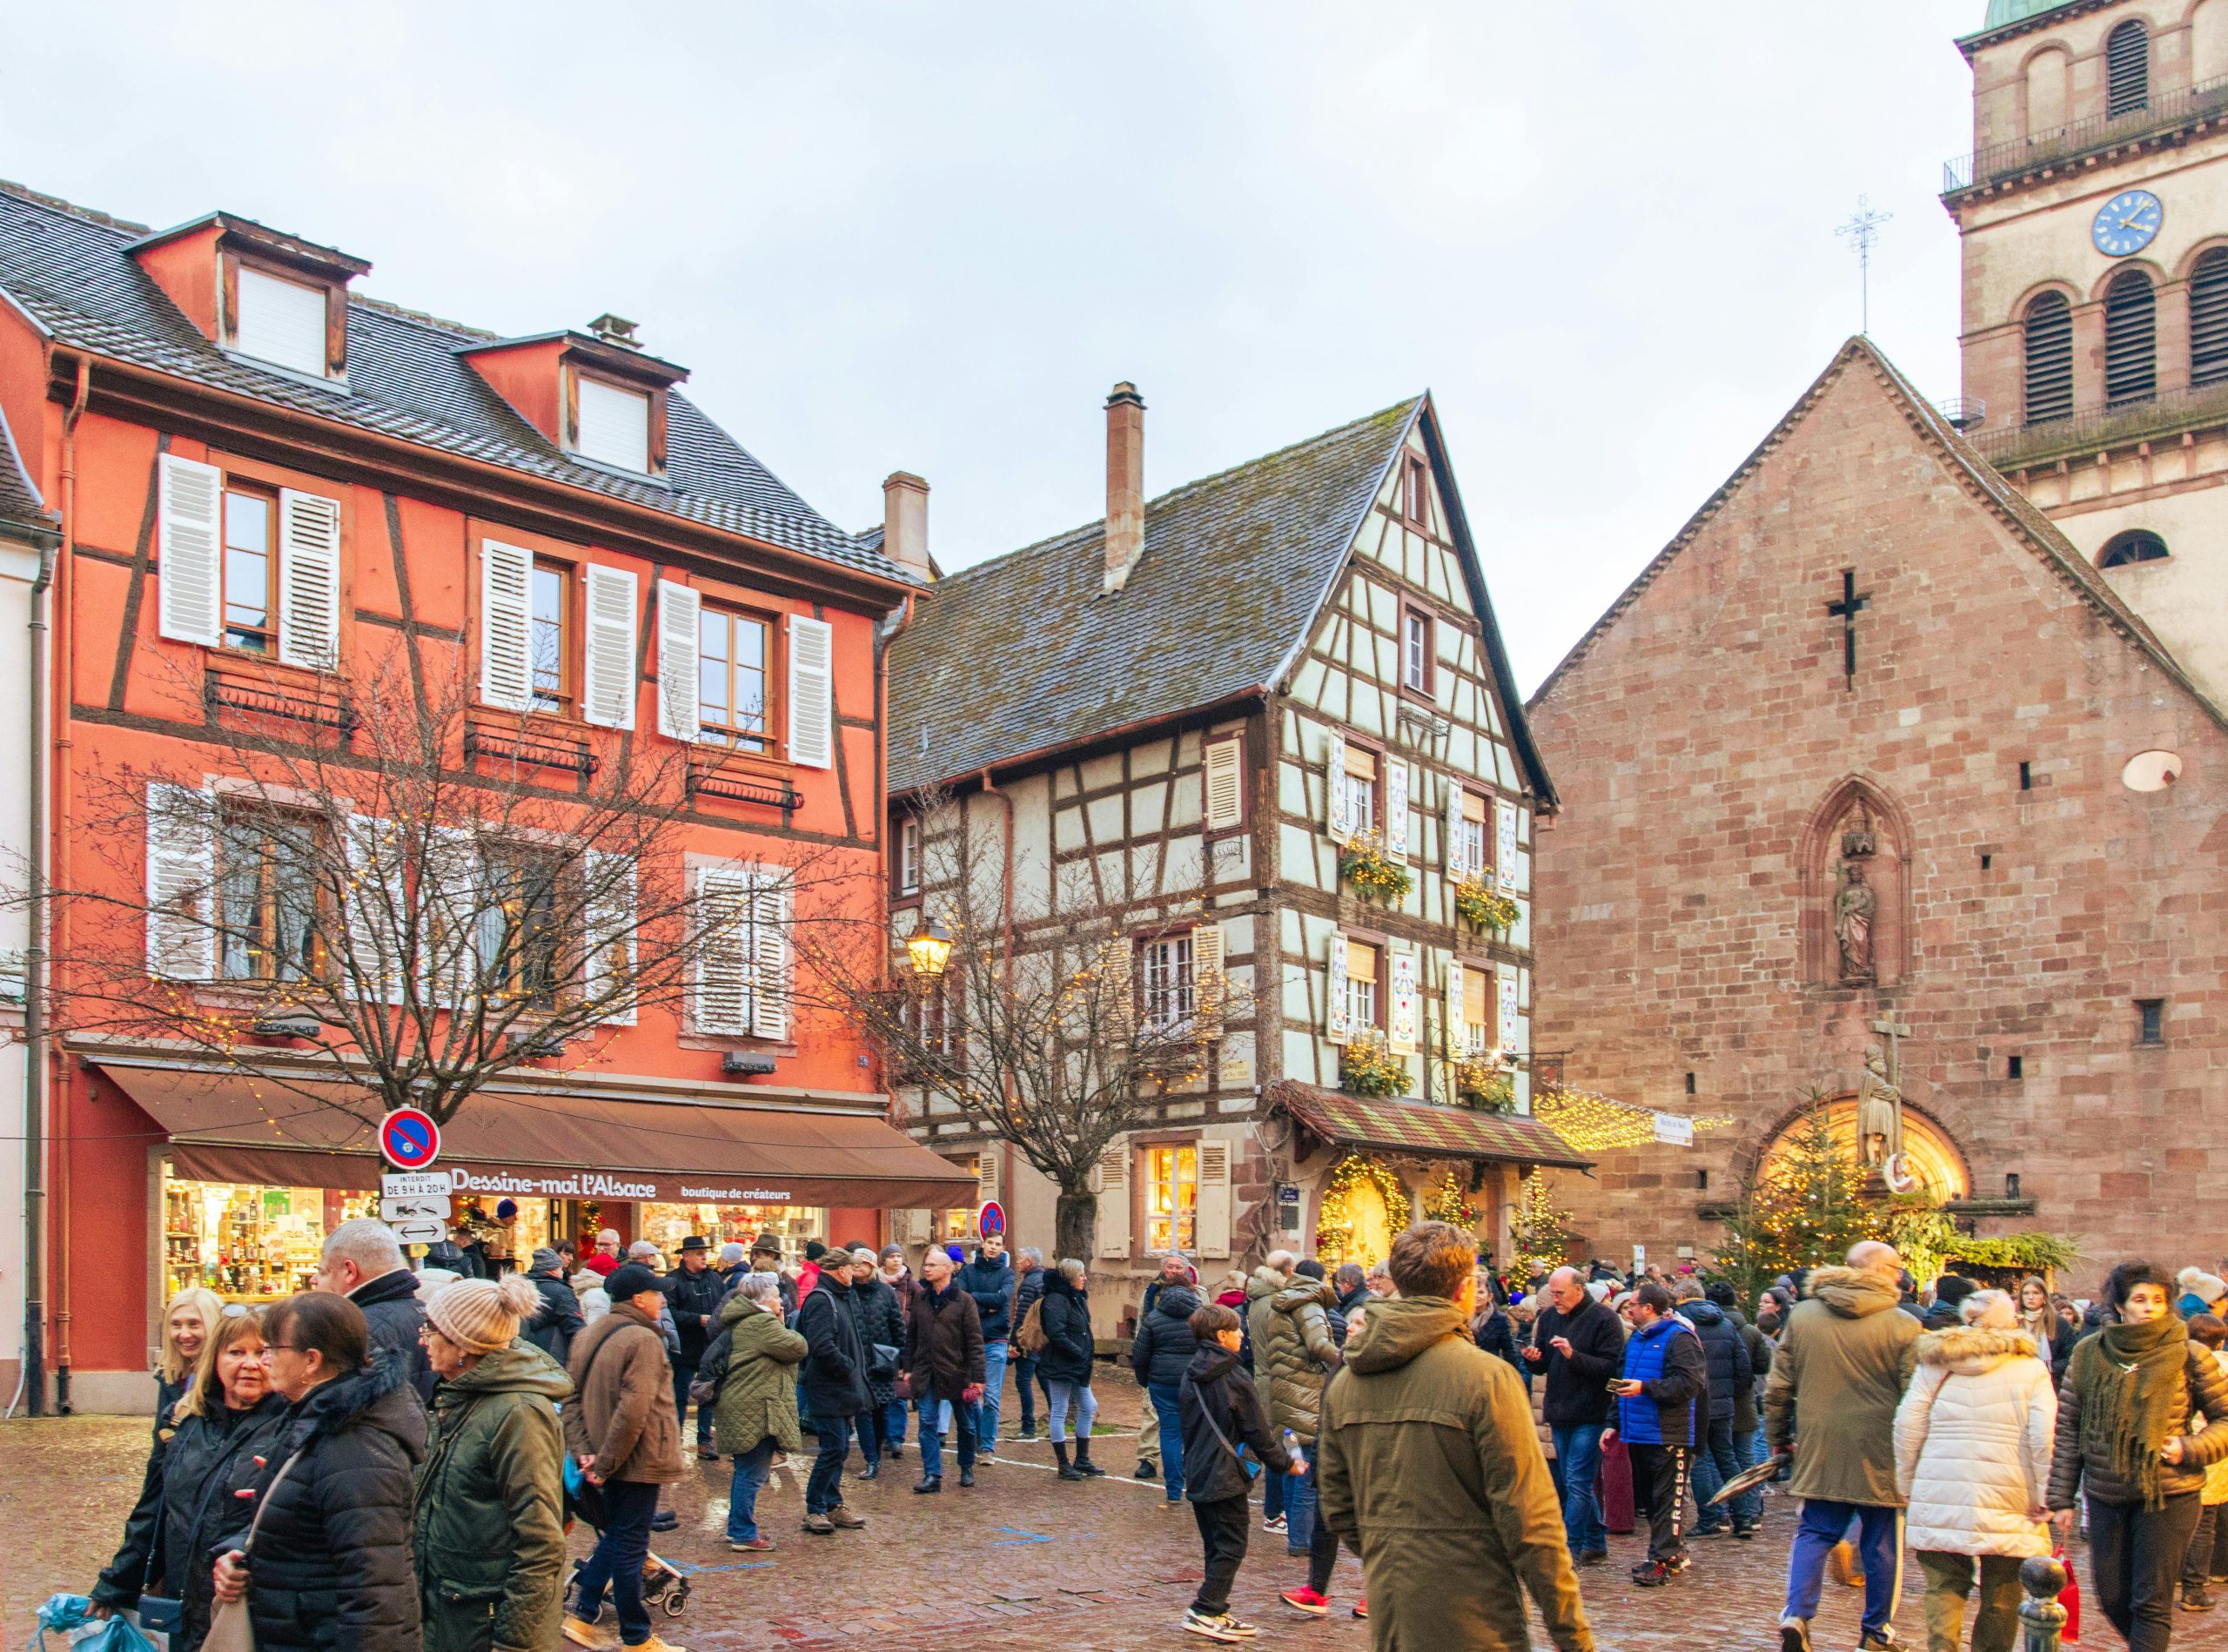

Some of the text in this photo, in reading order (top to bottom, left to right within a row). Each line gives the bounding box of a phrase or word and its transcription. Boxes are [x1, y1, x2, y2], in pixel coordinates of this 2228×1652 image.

[387, 1185, 399, 1195] DE
[452, 1168, 656, 1197] Dessine-moi l'Alsace
[681, 1186, 790, 1199] boutique de créateurs
[1671, 1447, 1685, 1521] Reebok
